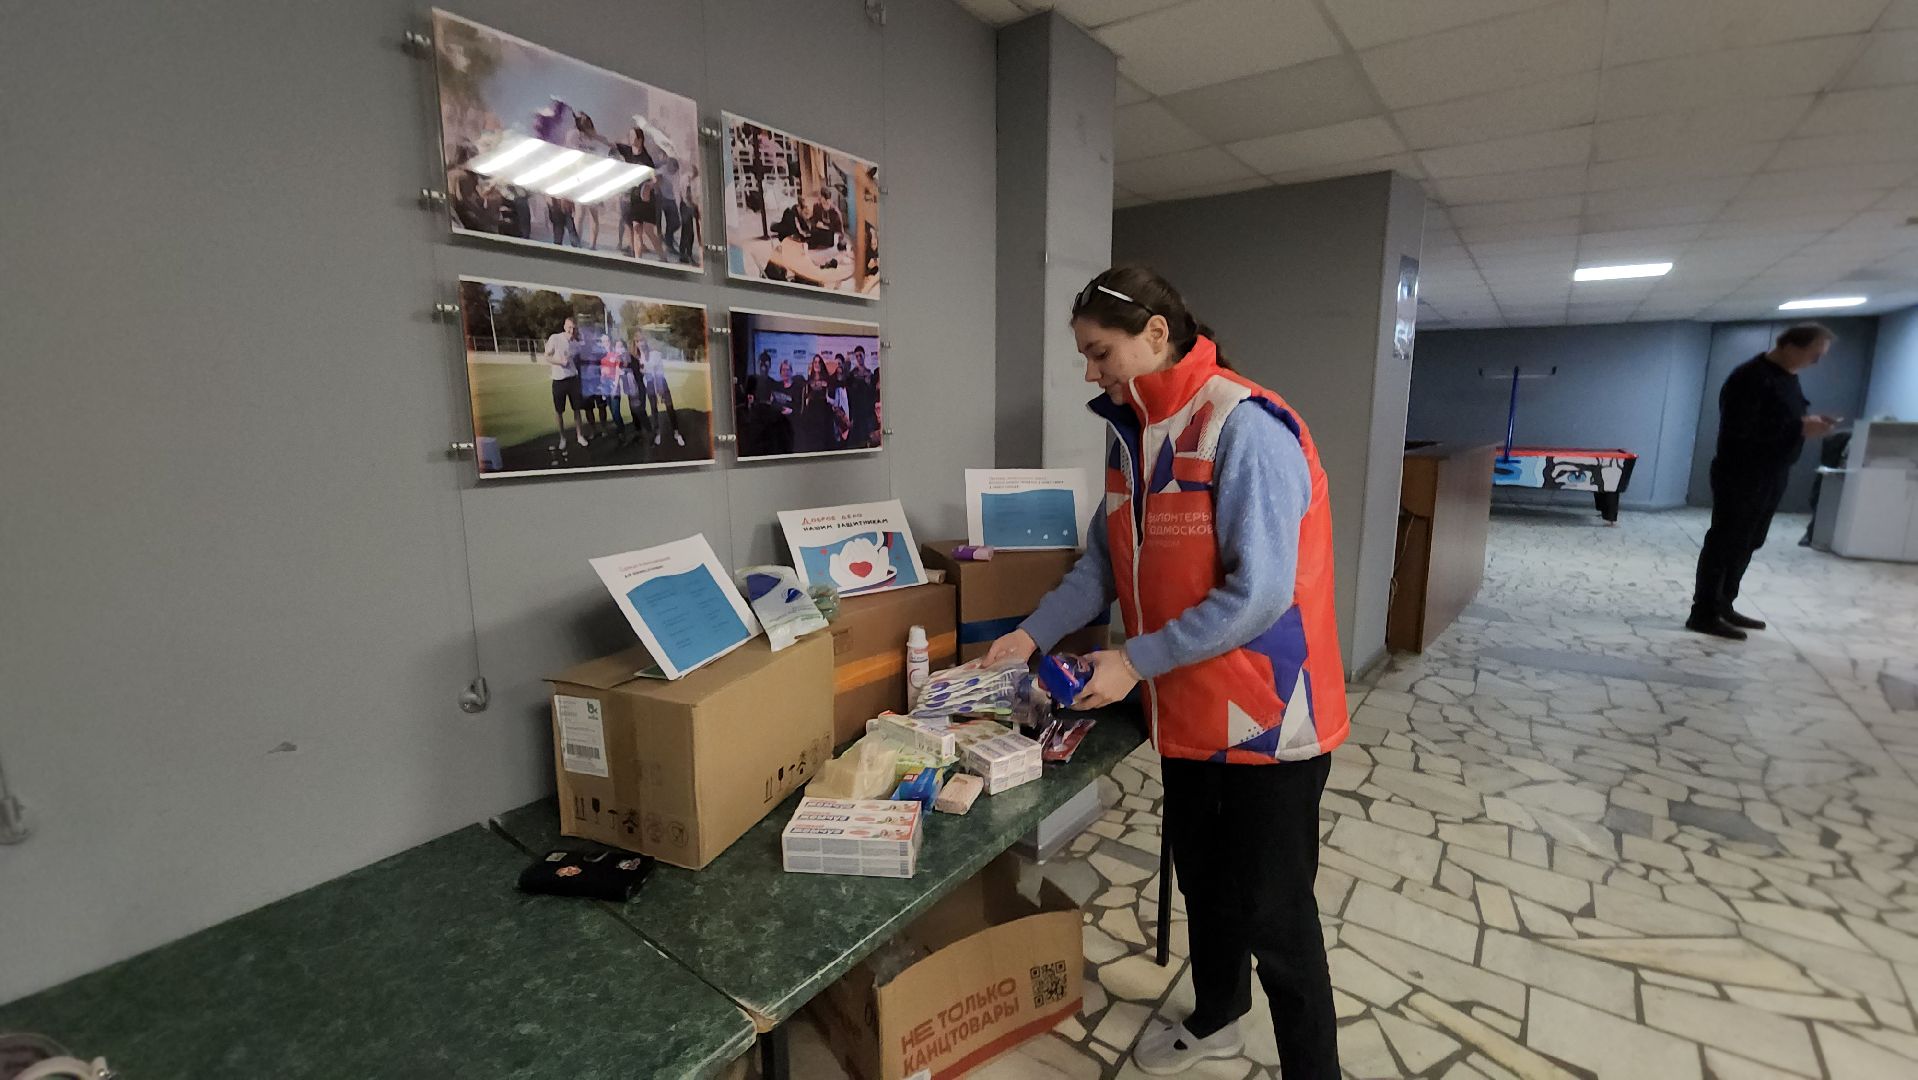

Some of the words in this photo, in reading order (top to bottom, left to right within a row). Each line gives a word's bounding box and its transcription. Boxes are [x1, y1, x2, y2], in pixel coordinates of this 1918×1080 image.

[803, 524, 833, 532] НАШИМ
[837, 518, 889, 529] ЗАЩИТНИКАМ
[901, 1018, 935, 1055] НЕ
[937, 977, 1017, 1028] ТОЛЬКО
[903, 996, 1020, 1077] КАНЦТОВАРЫ
